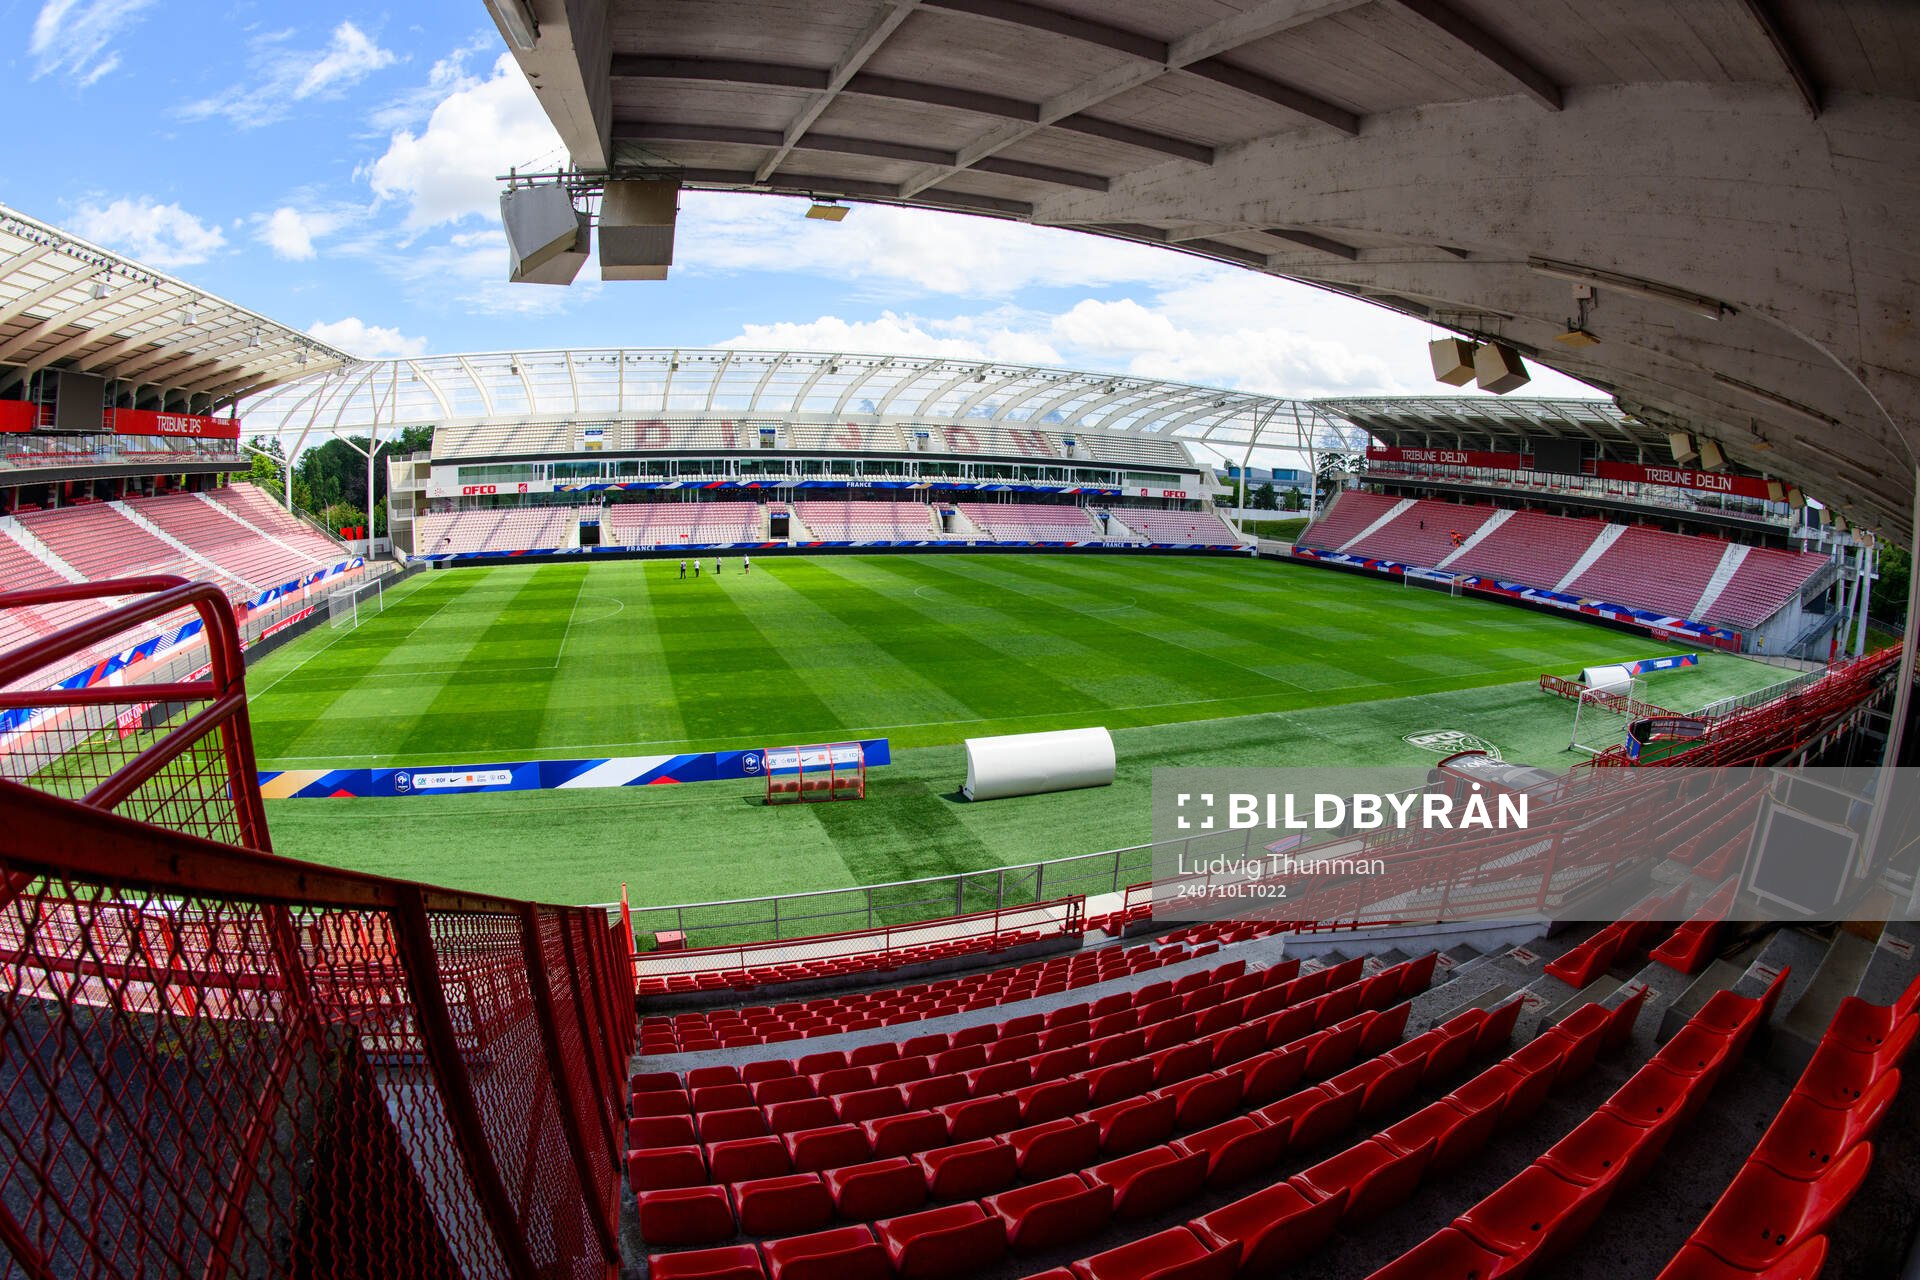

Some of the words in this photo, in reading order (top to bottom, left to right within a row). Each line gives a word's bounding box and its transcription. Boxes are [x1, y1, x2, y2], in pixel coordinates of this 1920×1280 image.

[157, 416, 188, 433] TRIBUNE
[189, 418, 202, 433] IPS
[1401, 449, 1437, 462] TRIBUNE
[1440, 451, 1468, 463] DELIN
[1644, 468, 1692, 485] TRIBUNE
[1696, 474, 1732, 490] DELIN
